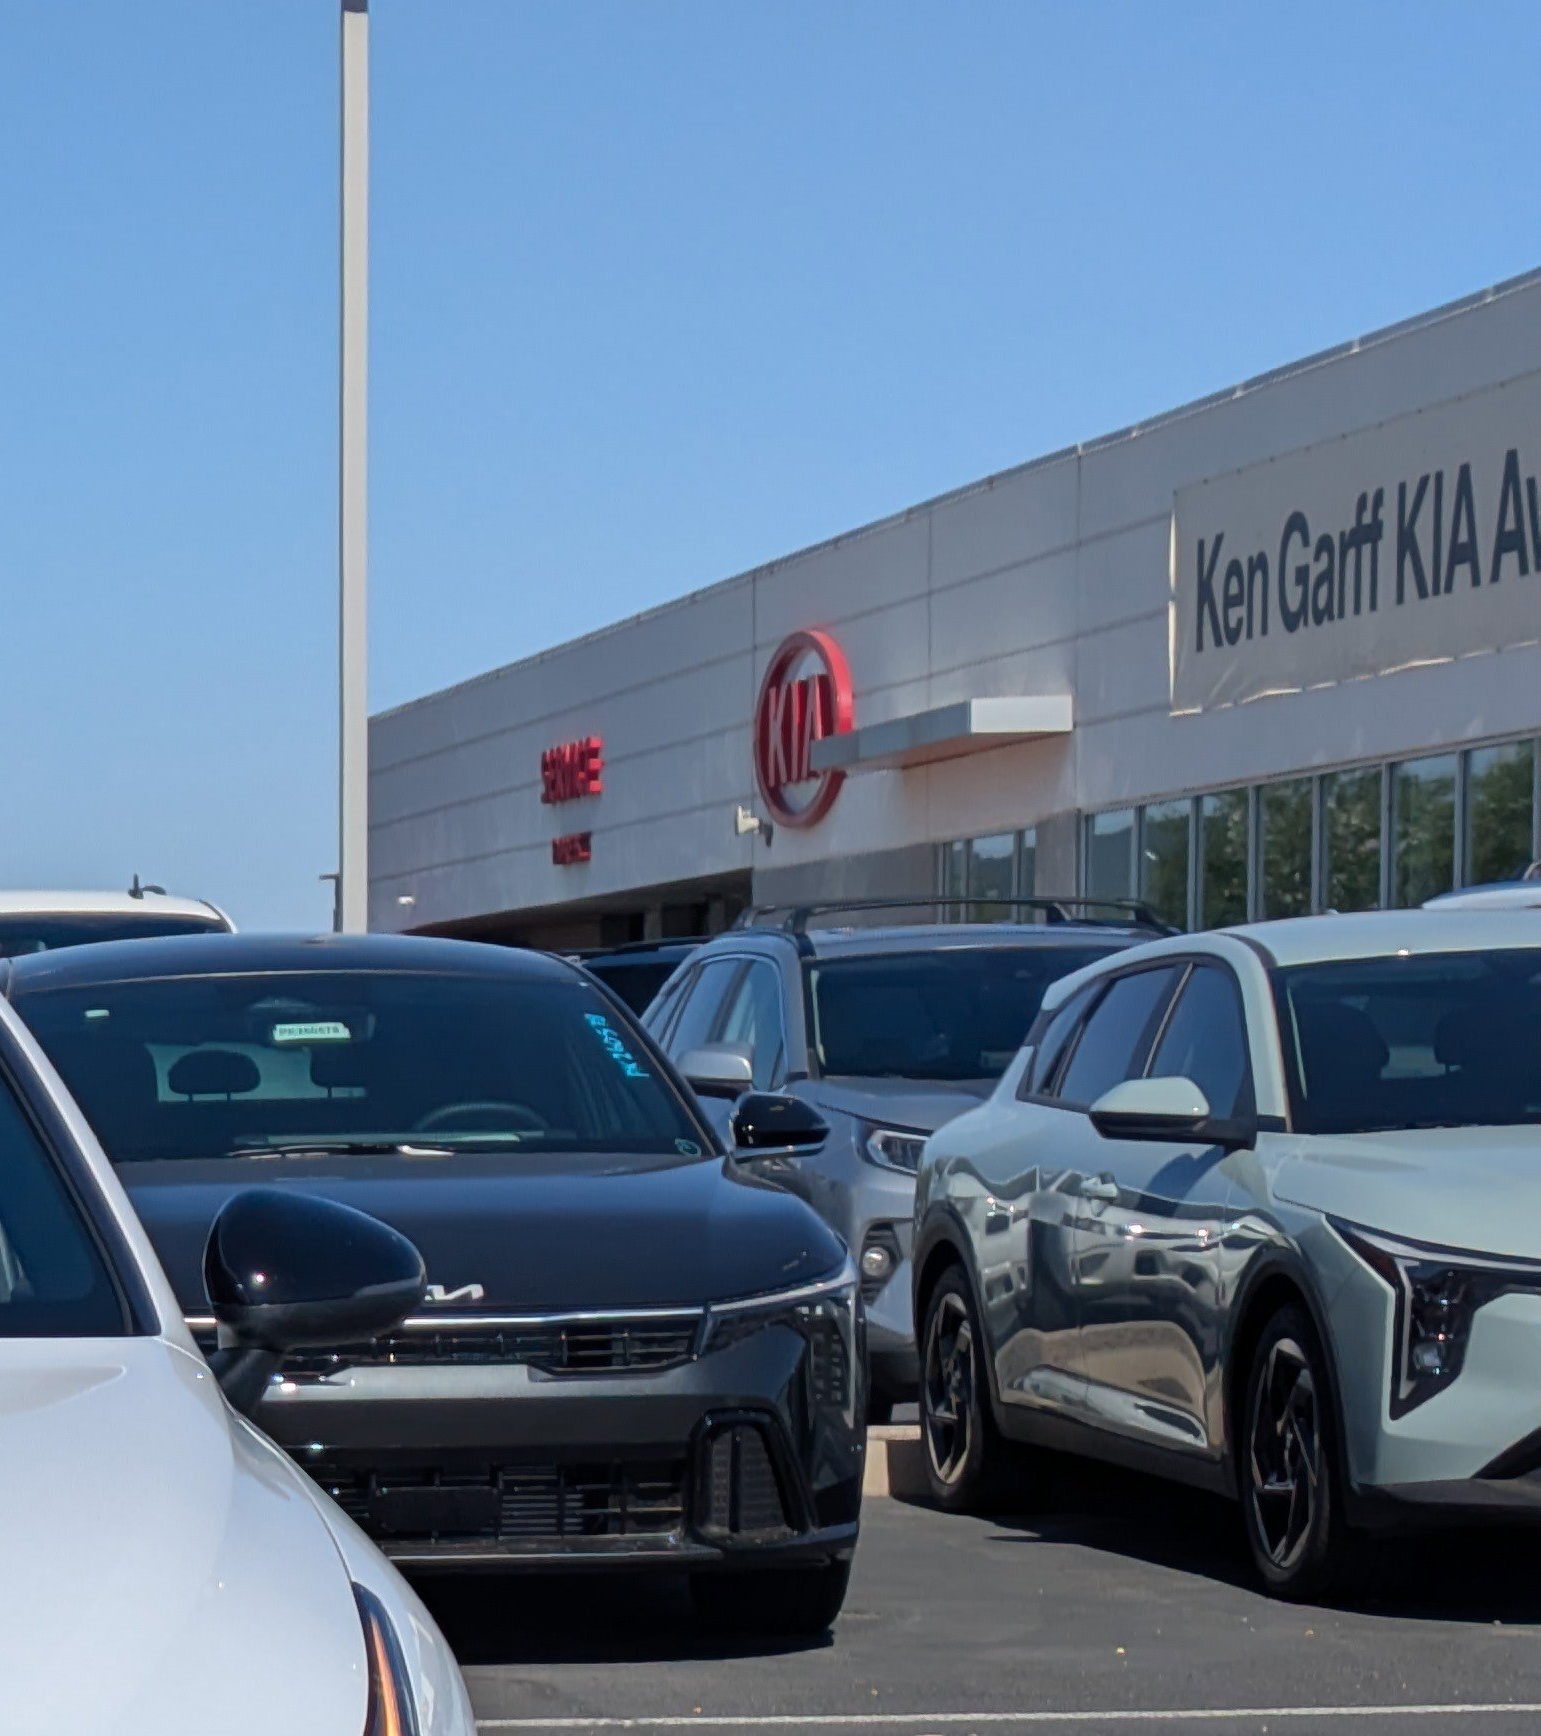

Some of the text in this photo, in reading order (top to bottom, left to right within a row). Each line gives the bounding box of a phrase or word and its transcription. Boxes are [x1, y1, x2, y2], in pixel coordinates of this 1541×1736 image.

[1195, 532, 1269, 653] Ken
[1278, 487, 1384, 635] Garff
[1395, 462, 1482, 606] KIA
